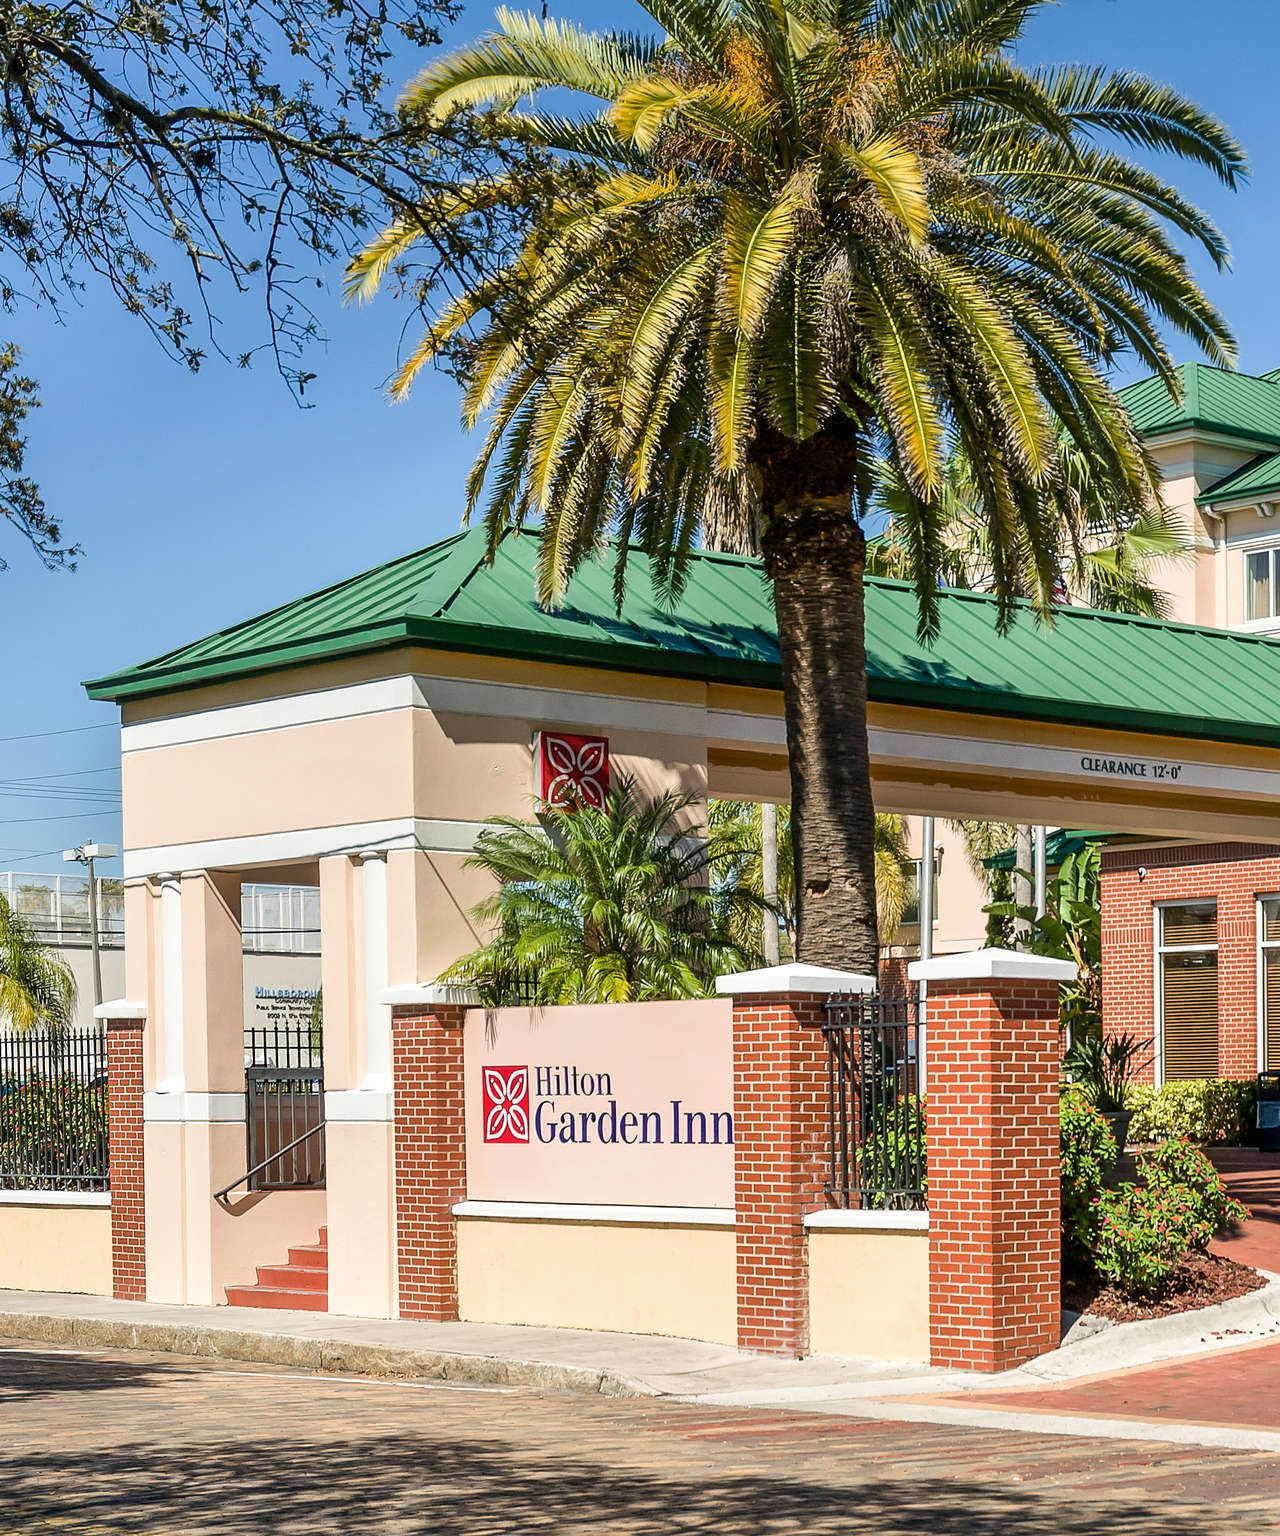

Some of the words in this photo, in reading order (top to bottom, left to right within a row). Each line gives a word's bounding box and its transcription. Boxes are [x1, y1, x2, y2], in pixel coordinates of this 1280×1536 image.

[1081, 757, 1147, 777] CLEARANCE
[534, 1066, 613, 1097] Hilton
[534, 1100, 664, 1144] Garden
[670, 1100, 735, 1145] Inn
